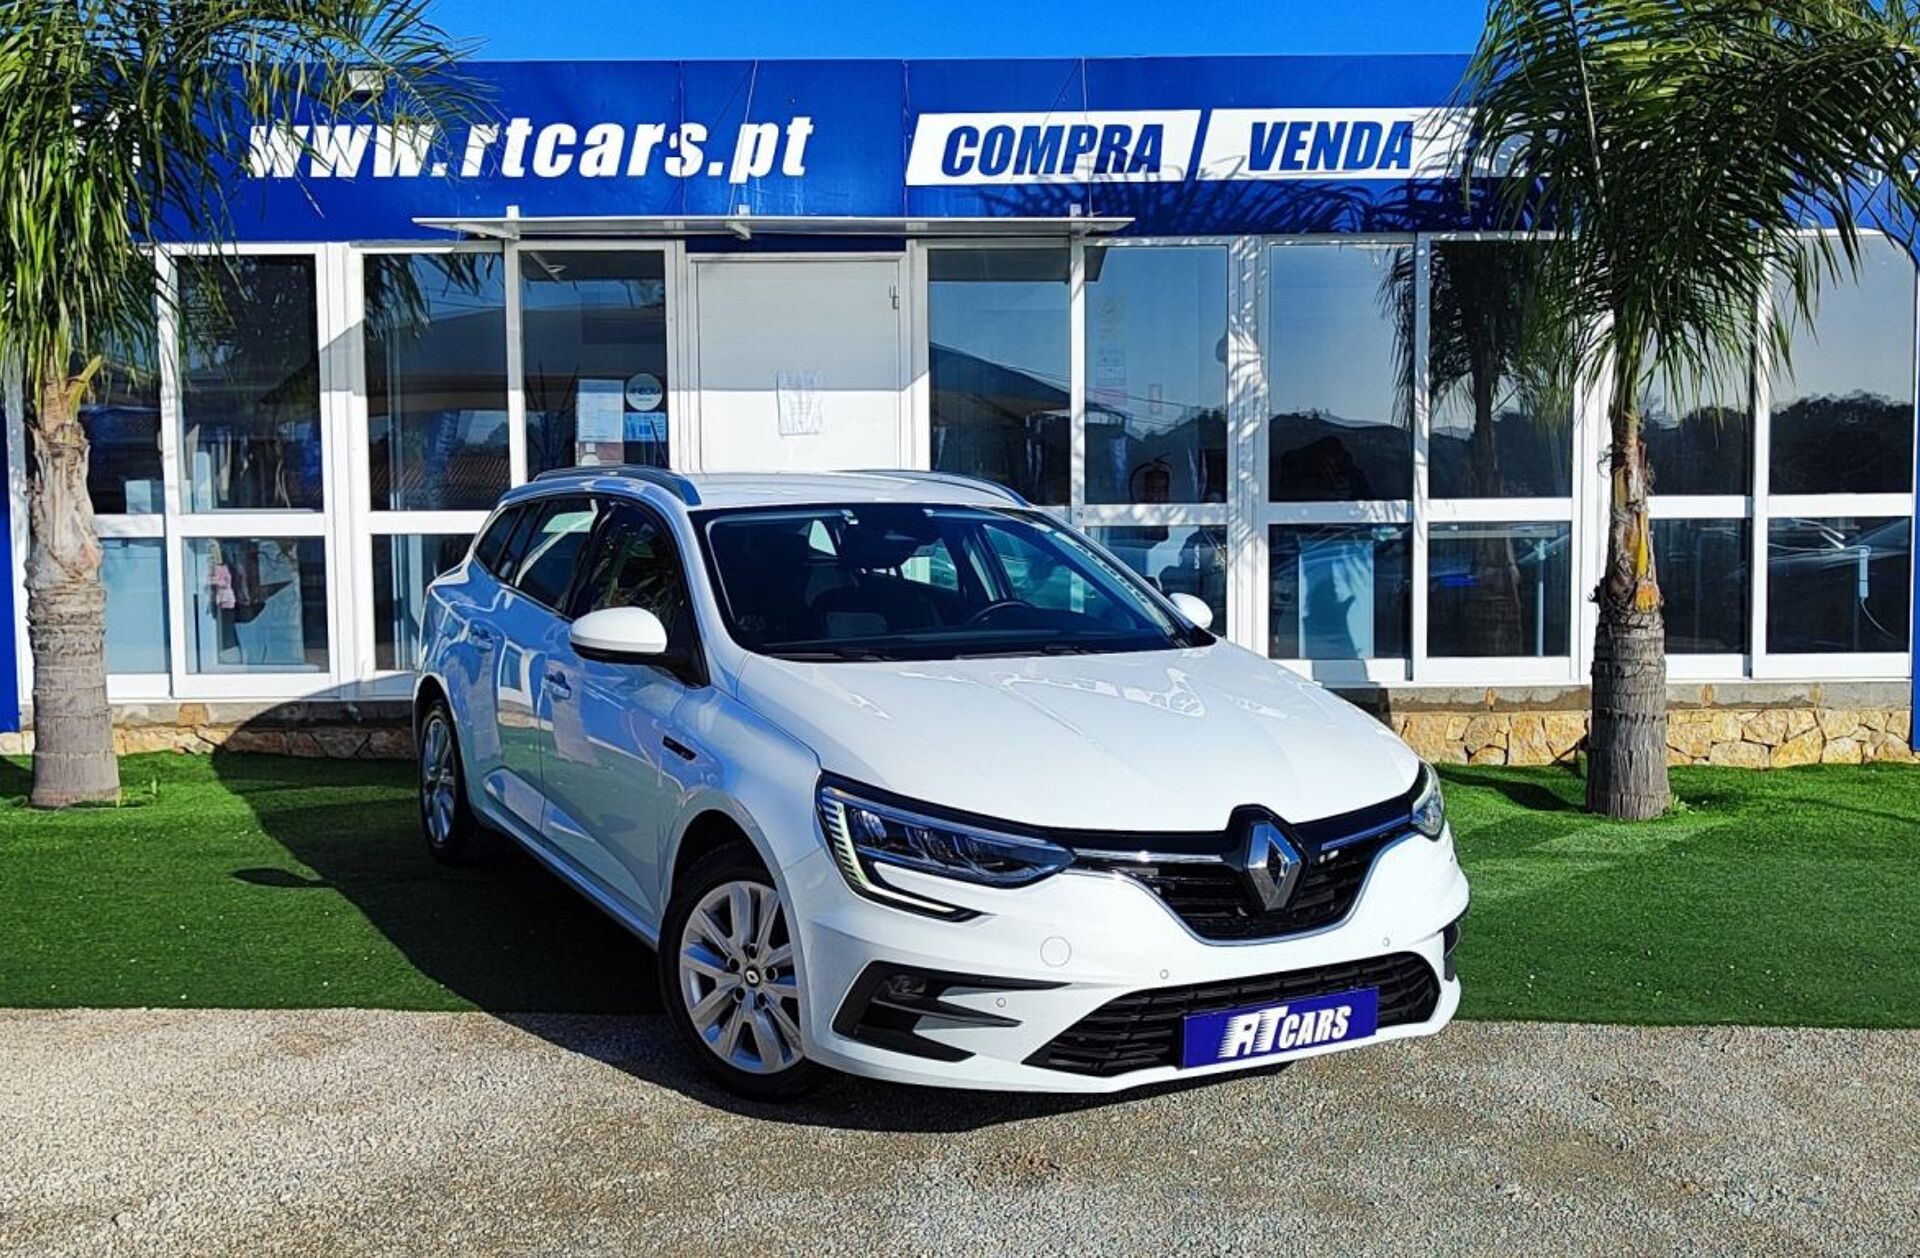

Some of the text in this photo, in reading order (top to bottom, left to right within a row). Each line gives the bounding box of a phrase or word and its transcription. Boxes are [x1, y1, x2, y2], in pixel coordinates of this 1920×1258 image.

[248, 116, 813, 184] www.rtcars.pt
[941, 125, 1164, 177] COMPRA
[1249, 121, 1413, 171] VENDA
